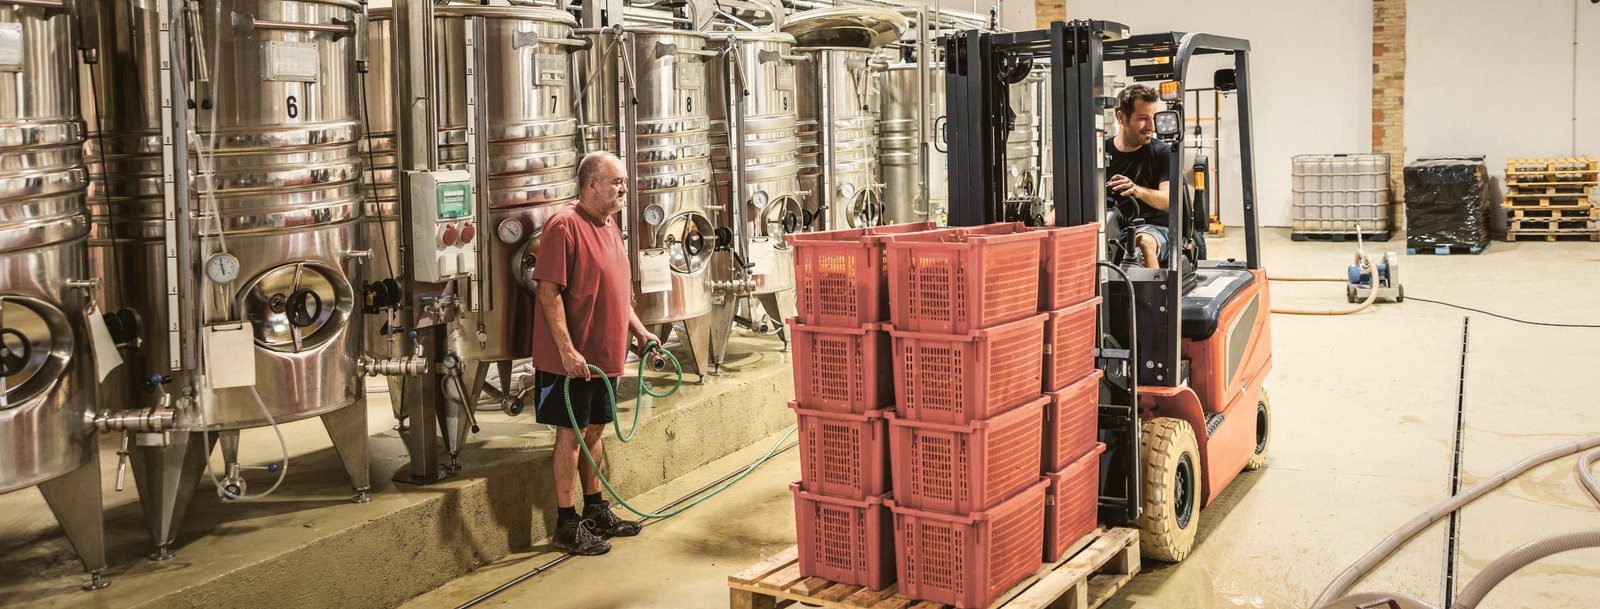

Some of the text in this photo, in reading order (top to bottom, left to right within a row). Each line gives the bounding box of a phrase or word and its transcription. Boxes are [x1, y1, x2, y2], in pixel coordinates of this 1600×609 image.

[286, 95, 298, 118] 6
[551, 96, 558, 114] 7
[686, 96, 692, 112] 8
[783, 96, 788, 110] 9
